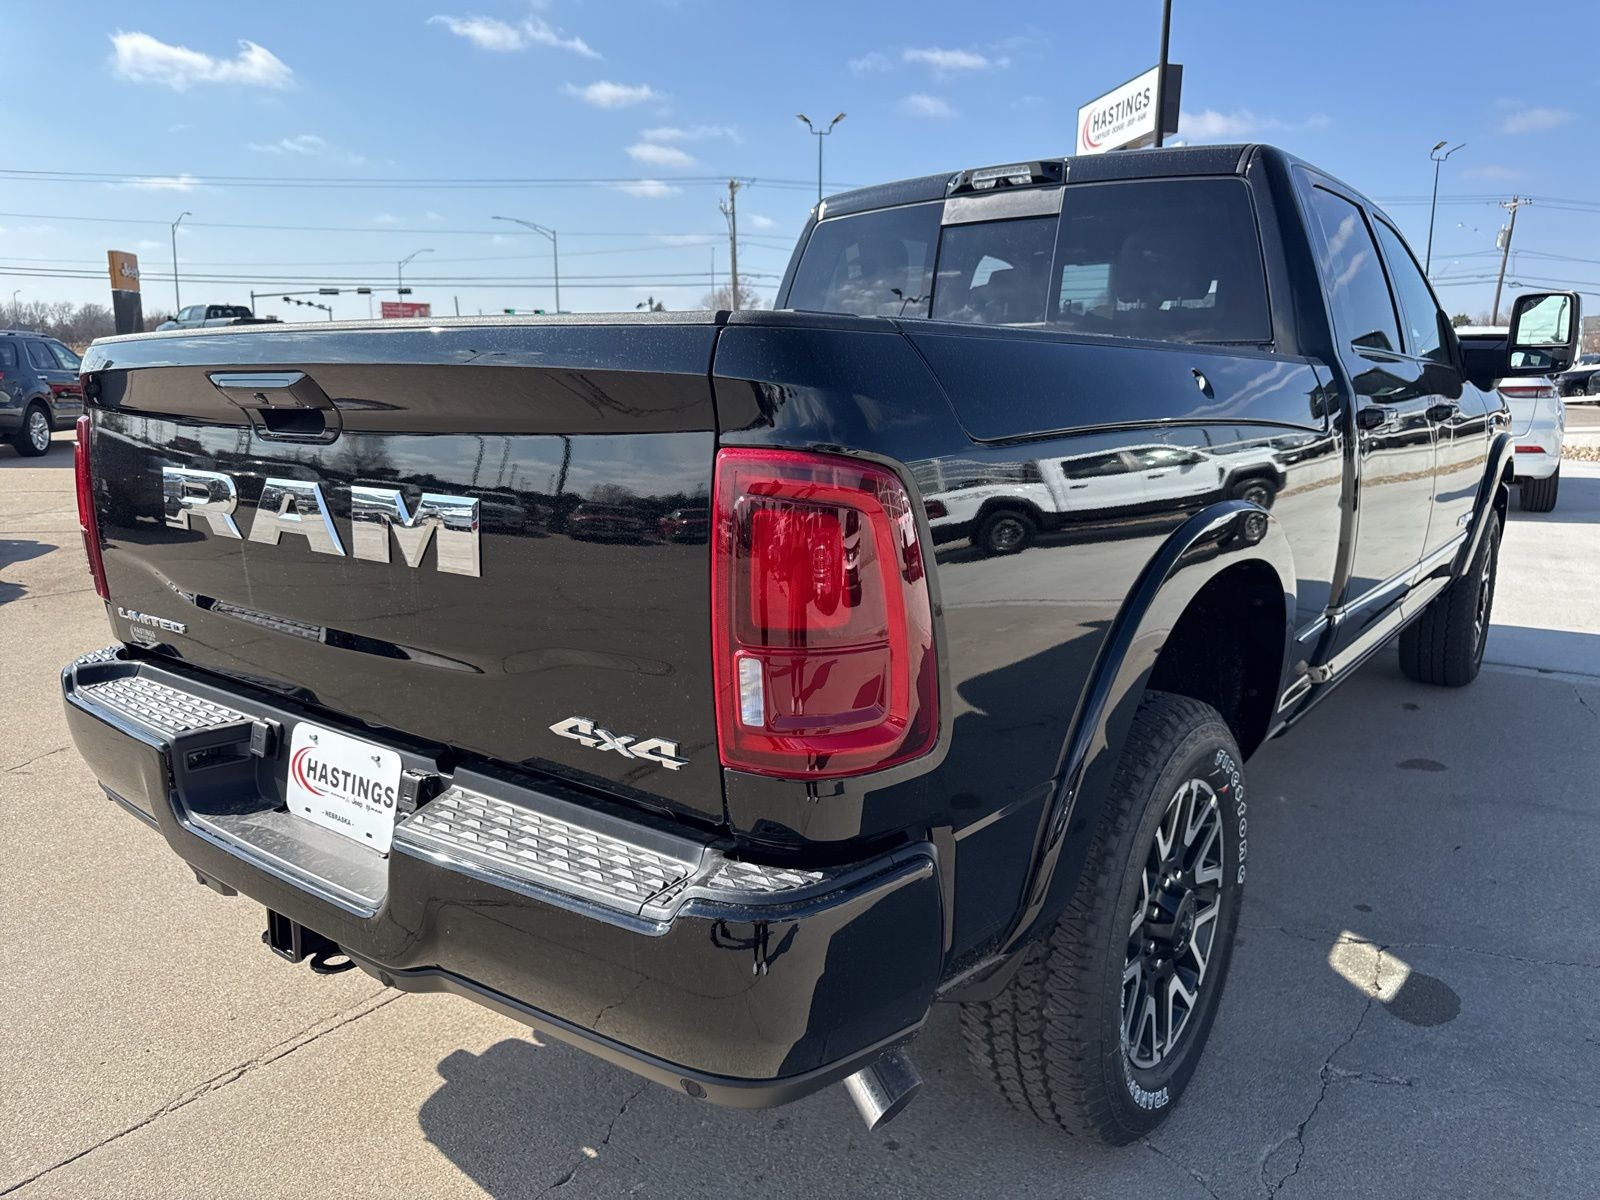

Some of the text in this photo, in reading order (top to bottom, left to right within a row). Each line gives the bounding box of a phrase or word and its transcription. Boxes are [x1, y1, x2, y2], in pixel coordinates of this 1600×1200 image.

[1092, 87, 1150, 133] HASTINGS
[163, 466, 481, 577] RAM
[118, 607, 188, 634] LIMITED
[306, 758, 395, 808] HASTINGS
[325, 811, 352, 827] NEBRASKA
